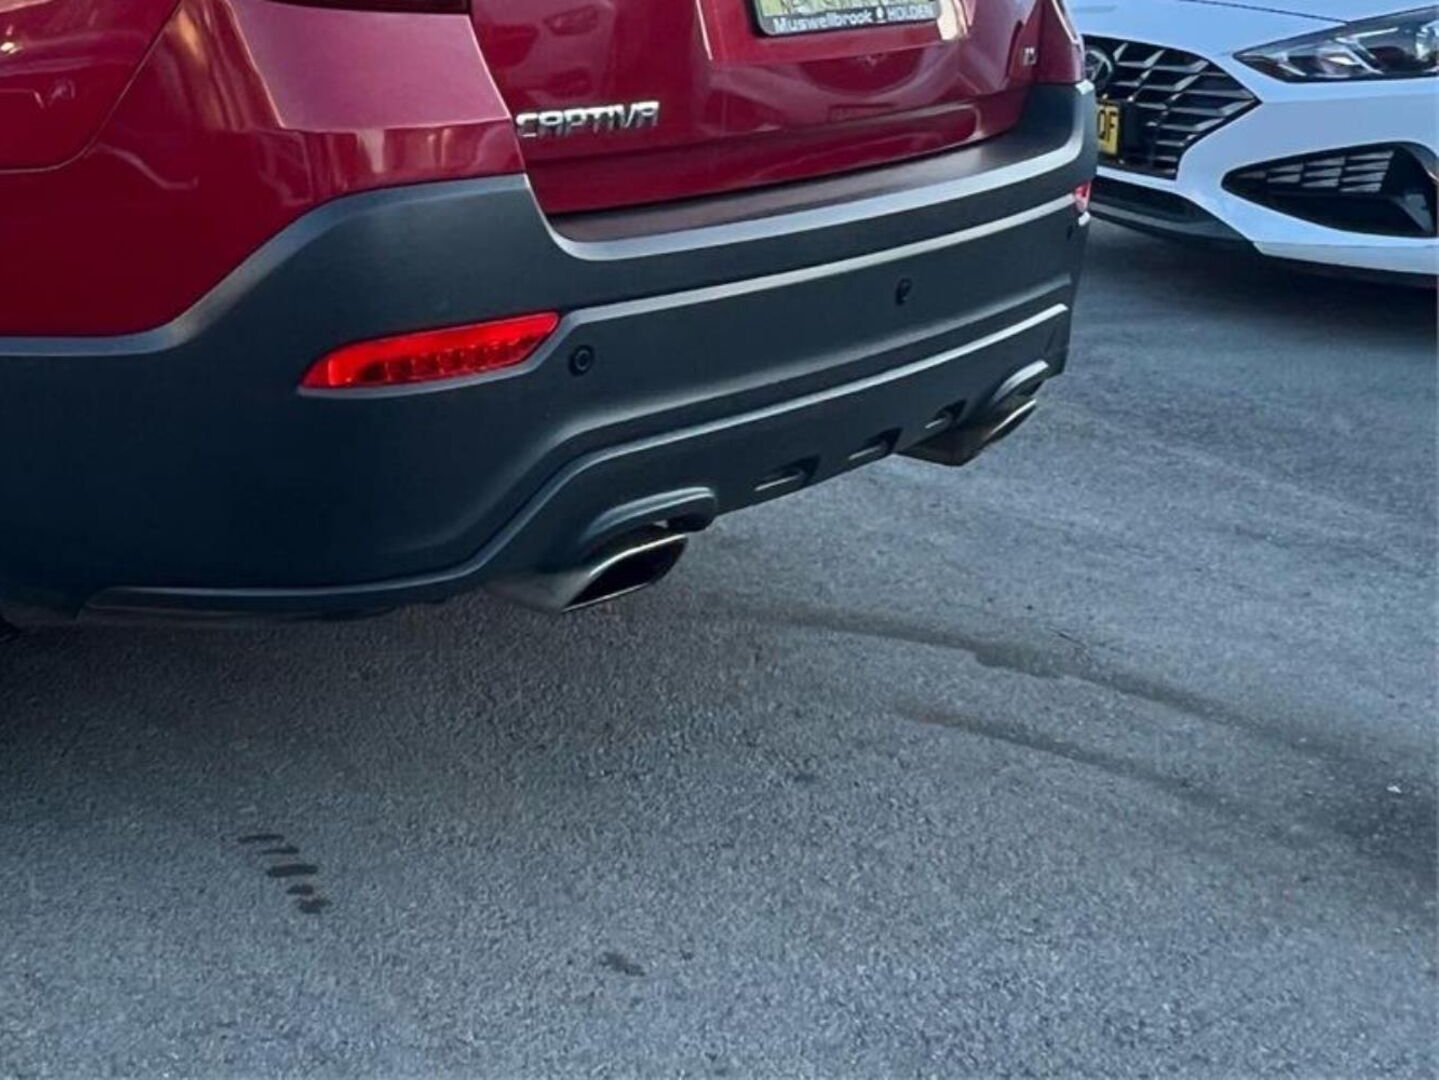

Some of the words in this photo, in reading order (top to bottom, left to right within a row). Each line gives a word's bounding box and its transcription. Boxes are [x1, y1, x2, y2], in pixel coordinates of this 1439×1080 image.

[772, 8, 873, 34] Muswellbrook
[886, 3, 934, 22] HOLDEN
[515, 100, 661, 138] CAPTIVA
